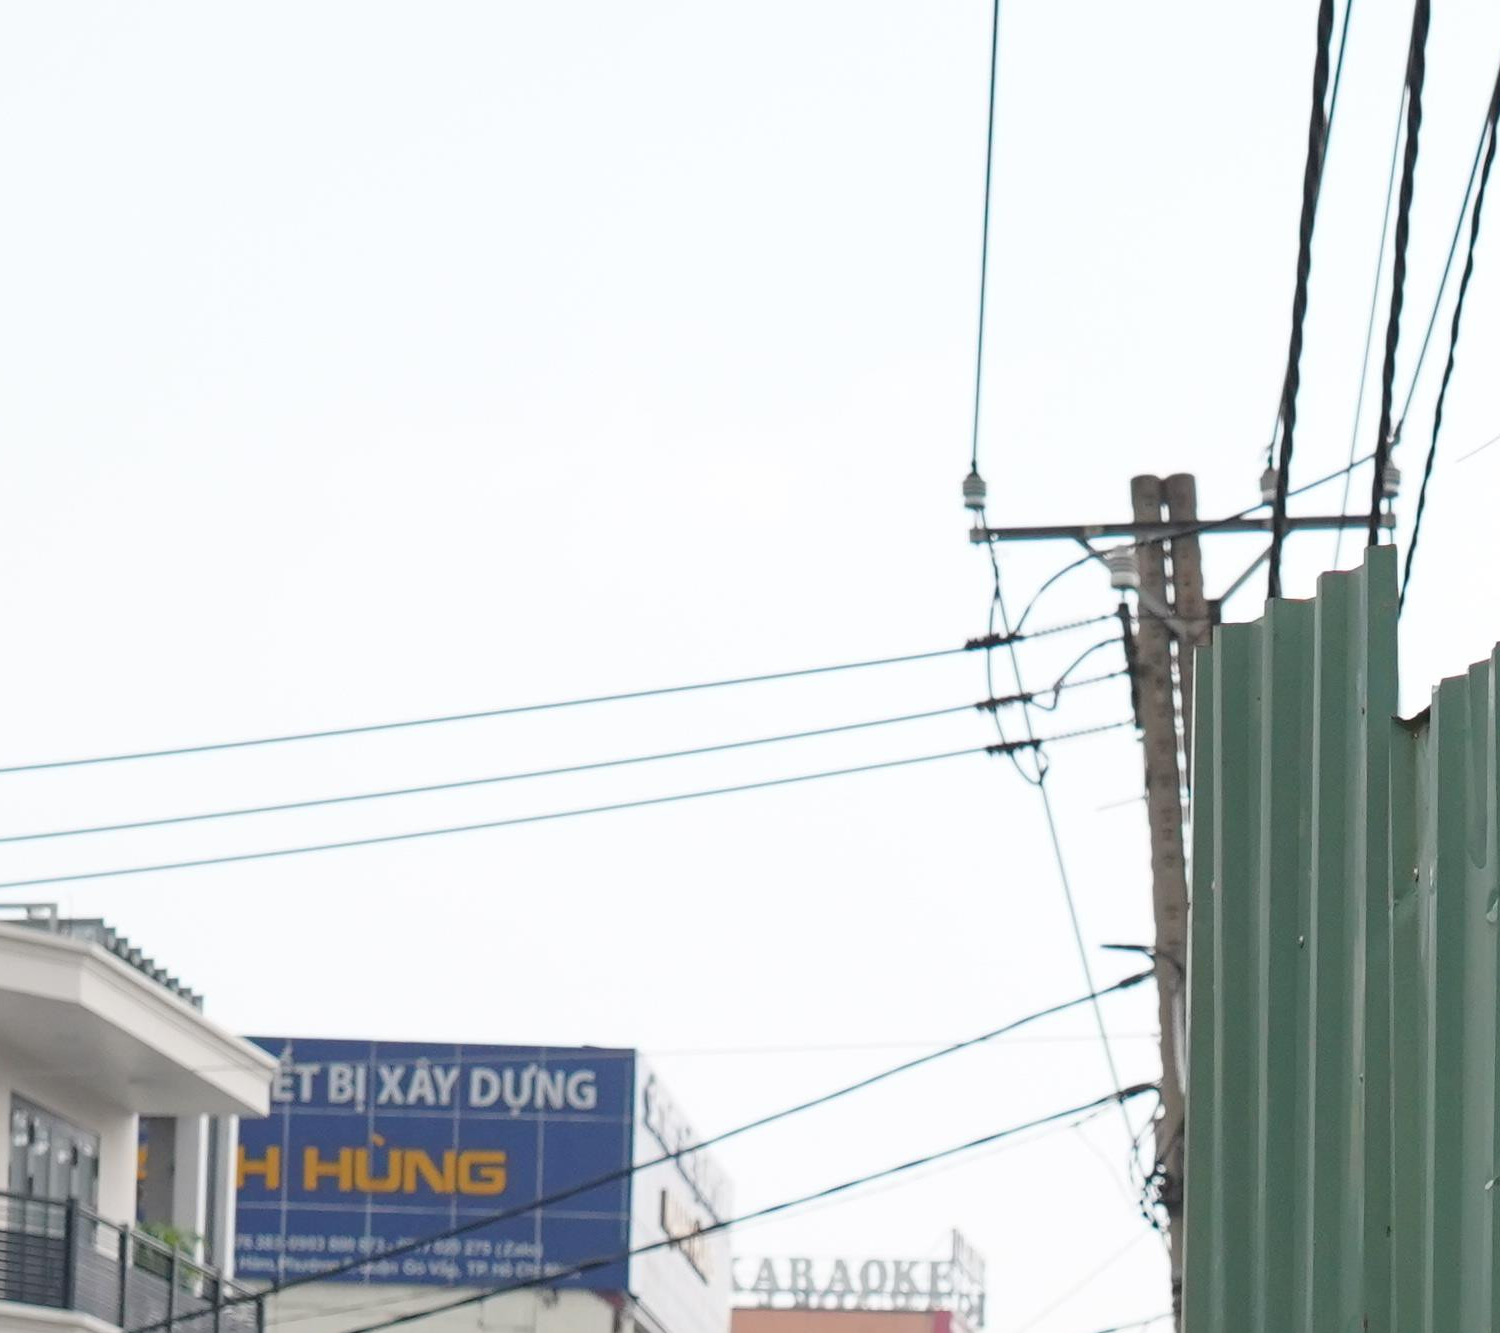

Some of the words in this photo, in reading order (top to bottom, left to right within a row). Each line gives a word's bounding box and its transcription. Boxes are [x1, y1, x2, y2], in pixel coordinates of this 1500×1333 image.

[271, 1046, 322, 1105] ẾT
[327, 1062, 367, 1115] BỊ
[378, 1057, 460, 1107] XÂY
[469, 1063, 598, 1118] DỰNG
[303, 1132, 507, 1196] HÙNG
